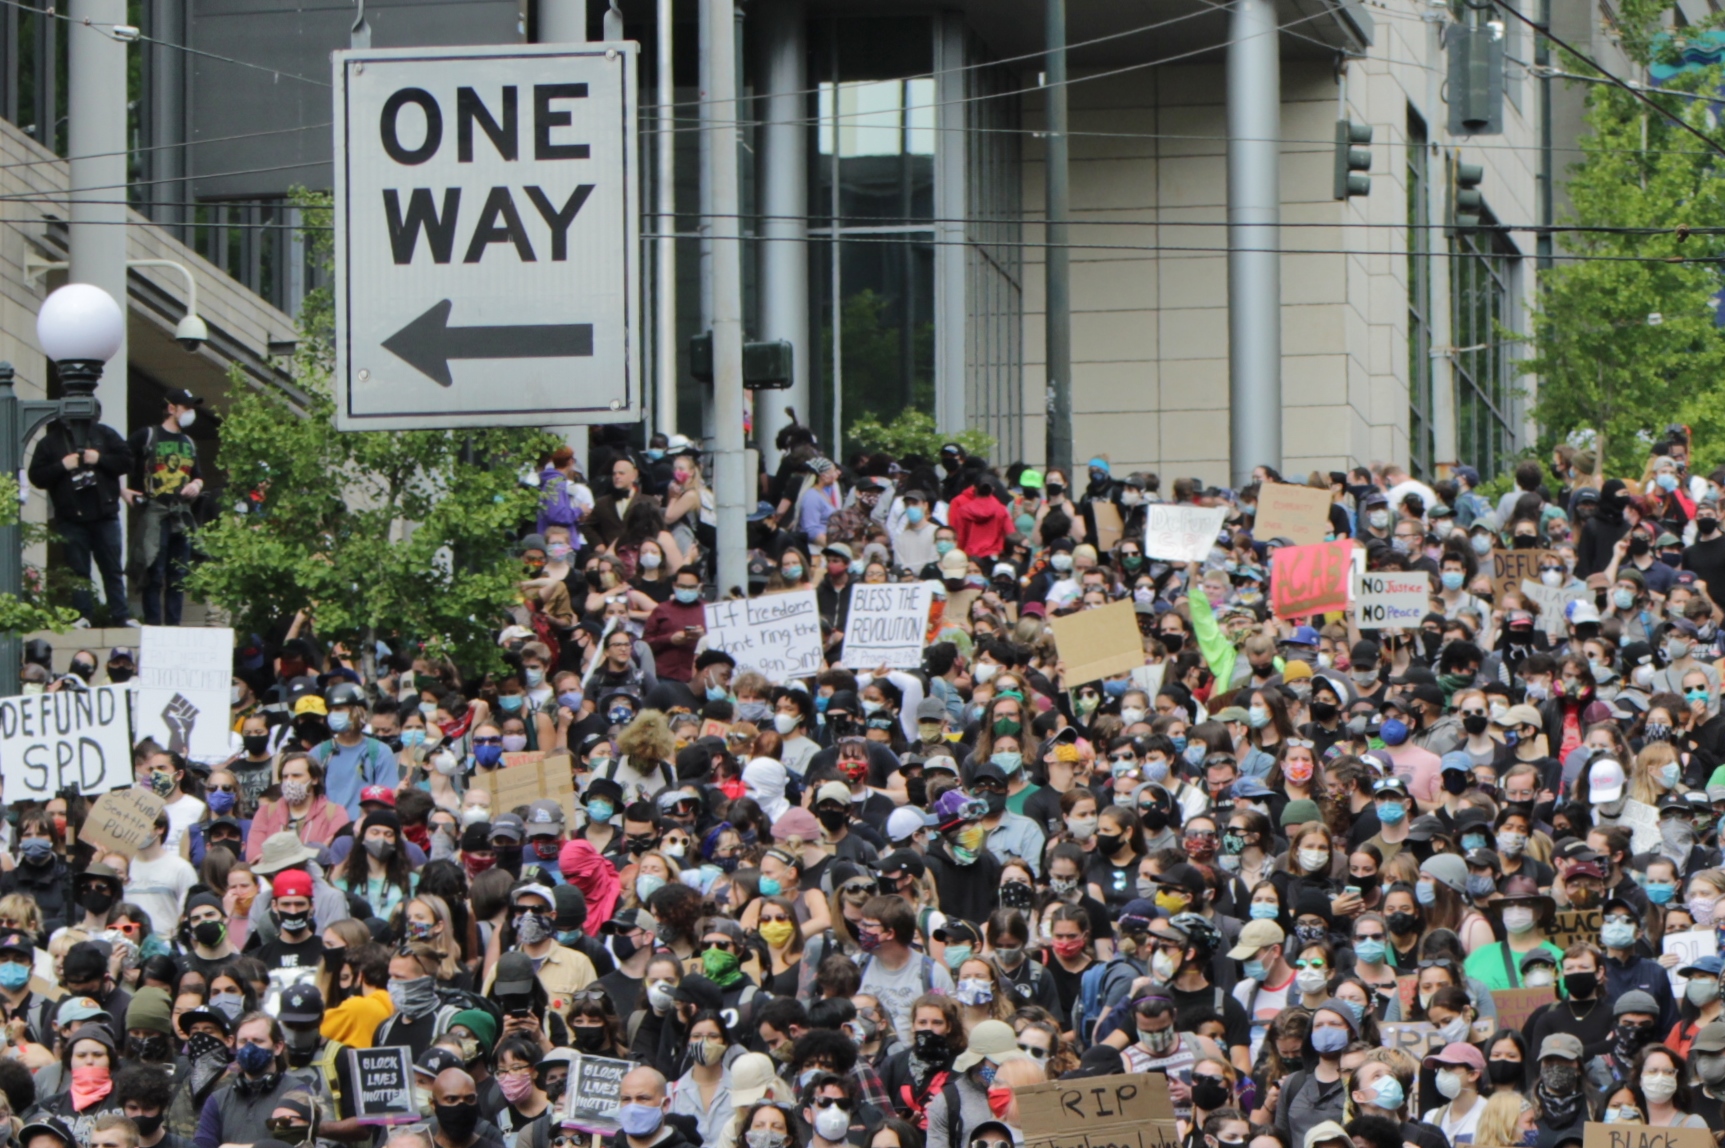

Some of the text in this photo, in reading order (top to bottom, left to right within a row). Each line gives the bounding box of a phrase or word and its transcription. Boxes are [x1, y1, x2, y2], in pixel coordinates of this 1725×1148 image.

[380, 82, 591, 165] ONE
[382, 184, 597, 266] WAY
[1494, 554, 1540, 580] DEFU
[854, 586, 920, 612] BLESS THE
[1361, 578, 1422, 595] NO Justice
[708, 602, 739, 630] If
[1361, 605, 1420, 621] NO Peace
[760, 627, 792, 648] ring
[793, 620, 819, 639] the
[852, 617, 922, 643] REVOLUTION
[0, 687, 115, 738] DEFUND
[22, 736, 105, 792] SPD
[1545, 911, 1603, 935] BLAC
[281, 953, 299, 967] WE
[362, 1055, 399, 1070] BLACK
[366, 1072, 398, 1086] LIVES
[584, 1079, 619, 1095] LIVES
[577, 1095, 621, 1111] MATTE
[1060, 1083, 1138, 1119] RIP
